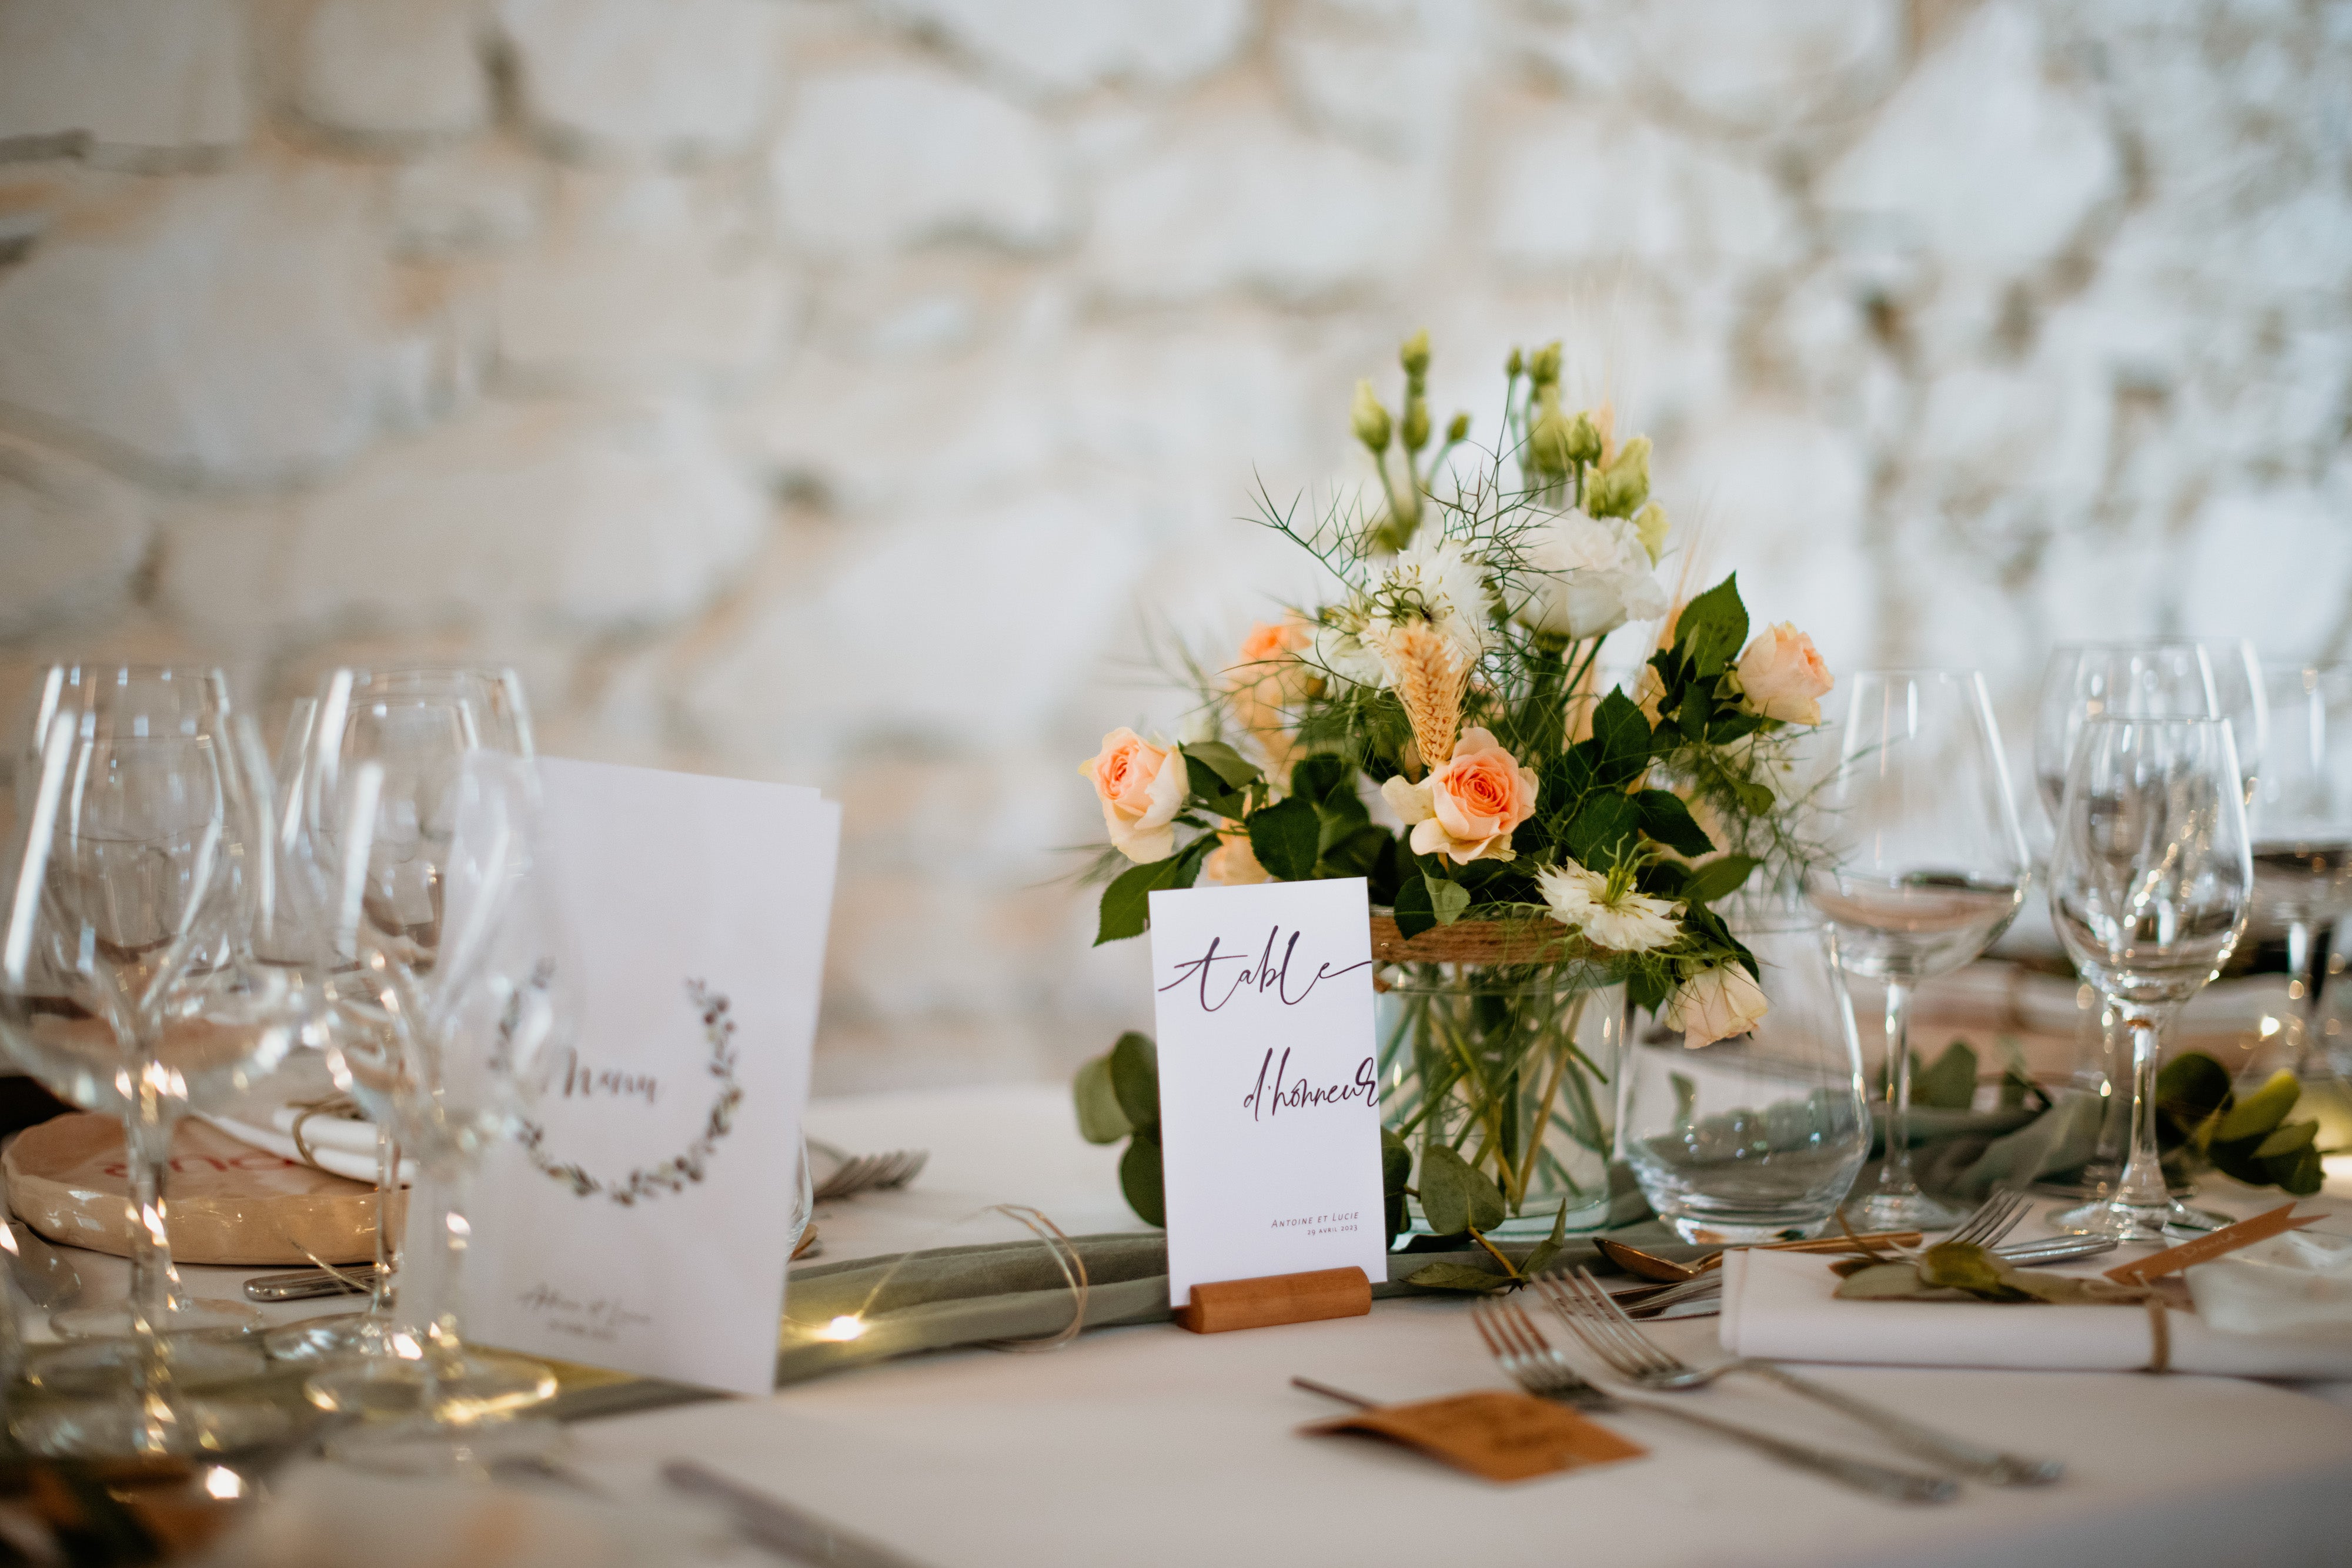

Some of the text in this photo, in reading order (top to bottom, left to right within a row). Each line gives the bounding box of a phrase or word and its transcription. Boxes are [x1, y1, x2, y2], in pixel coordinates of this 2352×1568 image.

[1157, 925, 1373, 1012] table
[1243, 1047, 1380, 1122] d'honneur
[1271, 1211, 1359, 1228] ANTOINE ET LUCIE
